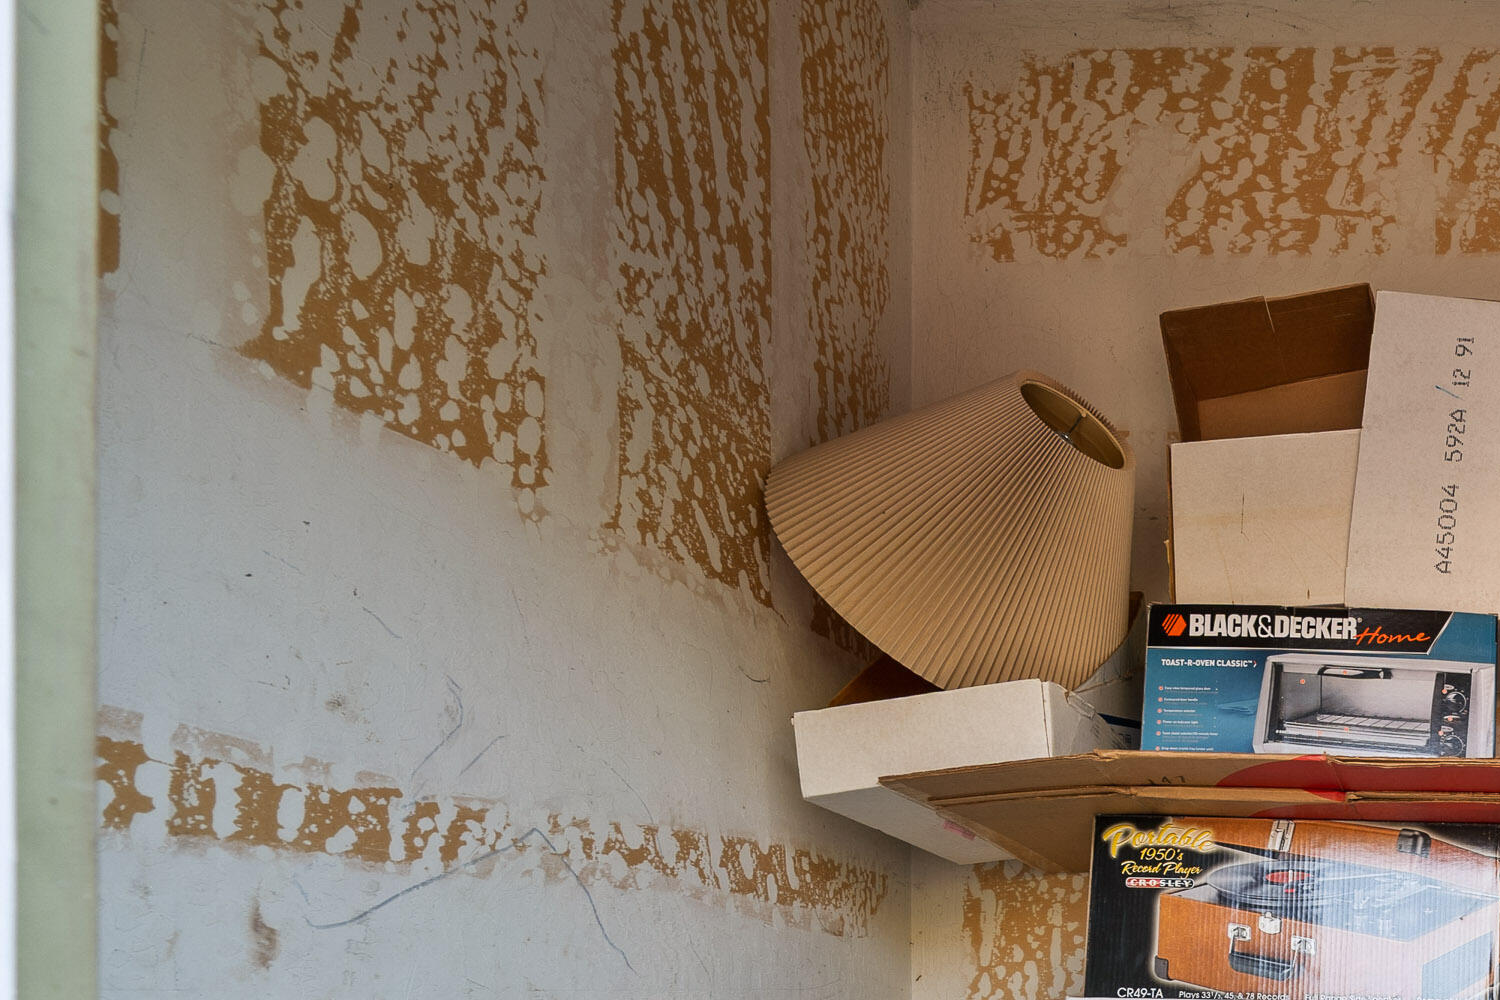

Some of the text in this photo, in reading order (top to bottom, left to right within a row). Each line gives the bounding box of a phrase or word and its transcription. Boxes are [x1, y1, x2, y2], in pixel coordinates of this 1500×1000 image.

[1434, 337, 1475, 574] A45004 592A 12 91
[1353, 626, 1431, 645] Home
[1161, 658, 1216, 667] TOAST-R-OVEN
[1103, 824, 1214, 858] Portable
[1140, 848, 1184, 861] 1950's
[1121, 861, 1203, 878] Record Player
[1130, 879, 1192, 888] CROSLEY
[1117, 987, 1164, 998] CR49-TA
[1179, 991, 1200, 1000] Plays
